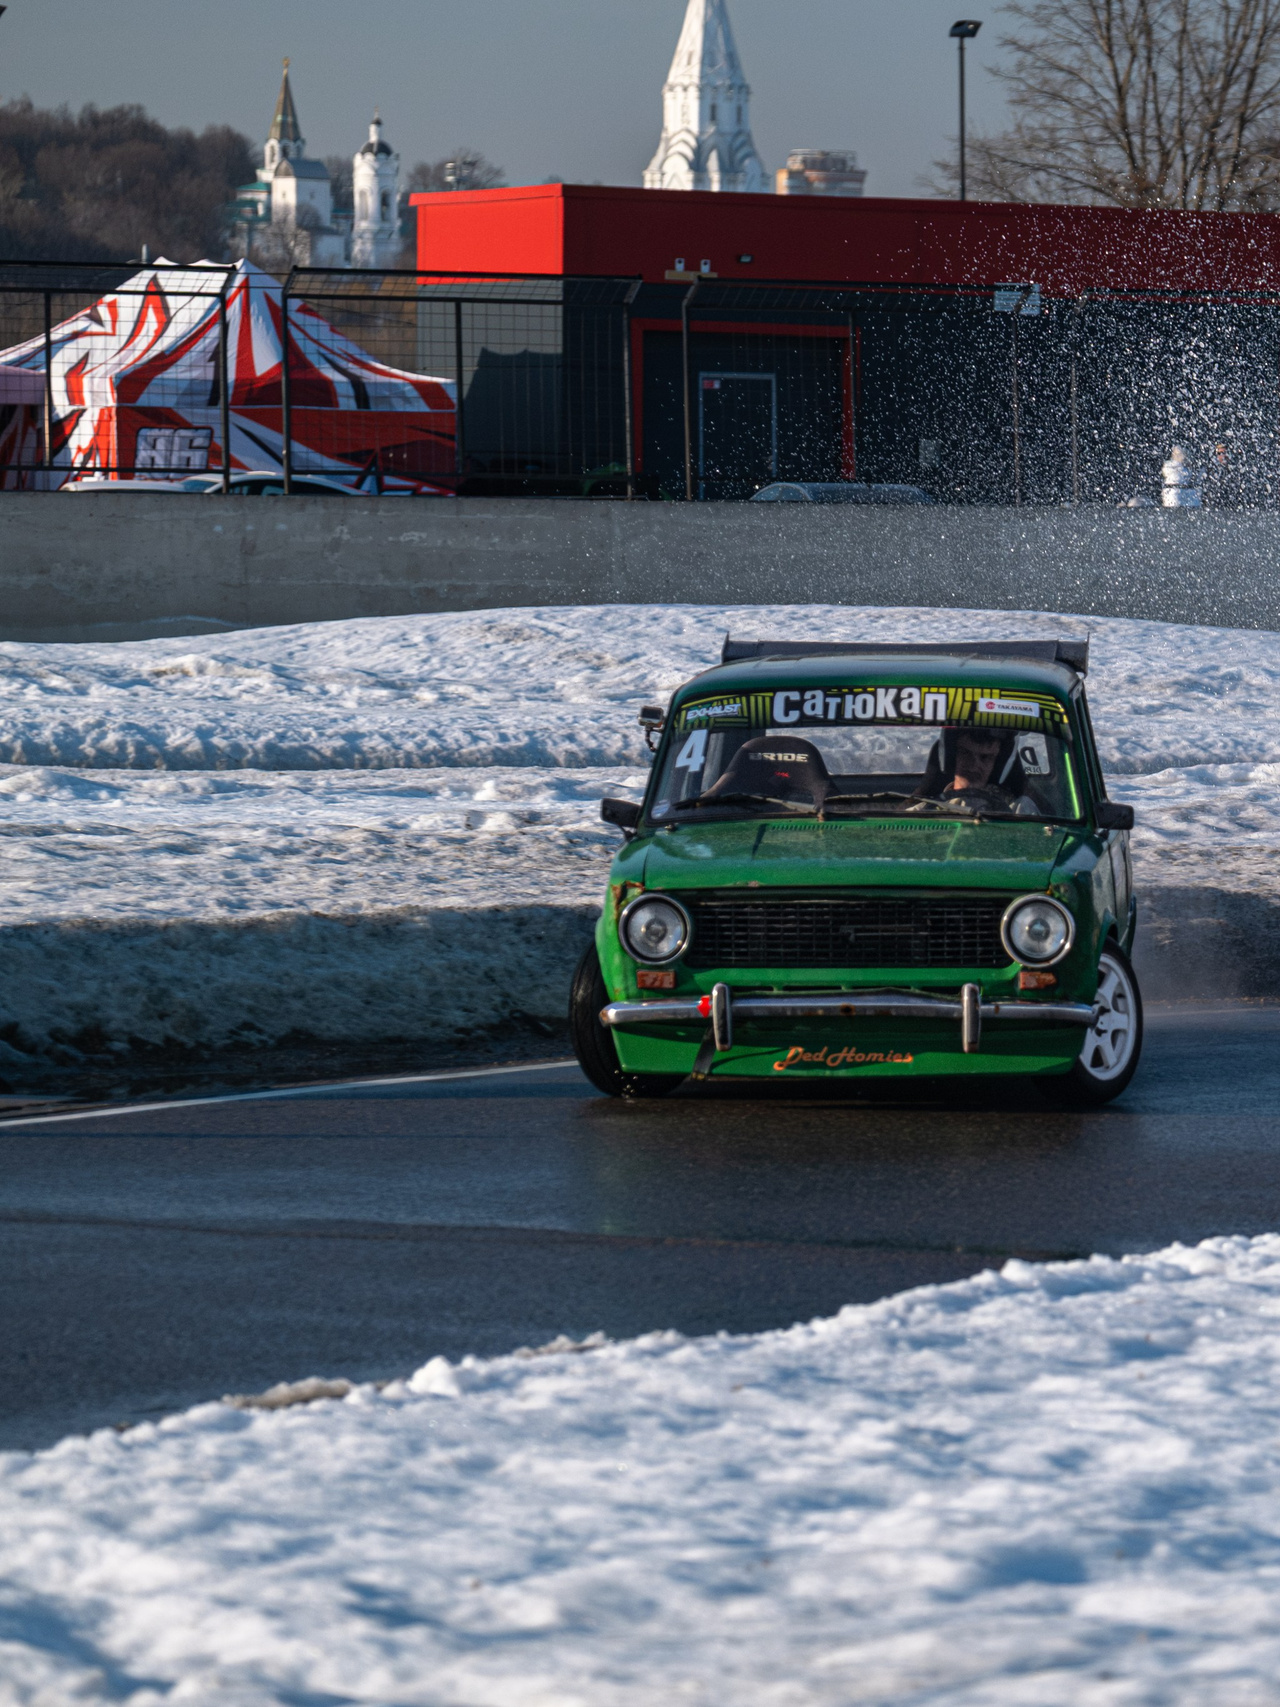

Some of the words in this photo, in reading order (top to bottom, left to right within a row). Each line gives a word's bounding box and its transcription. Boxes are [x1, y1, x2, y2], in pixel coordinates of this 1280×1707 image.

[686, 703, 741, 720] EXHAUST
[997, 704, 1033, 712] TAKAYAMA
[675, 729, 708, 772] 4
[748, 752, 809, 762] BRIDE
[773, 1046, 828, 1071] Ded
[826, 1046, 913, 1067] Homies
